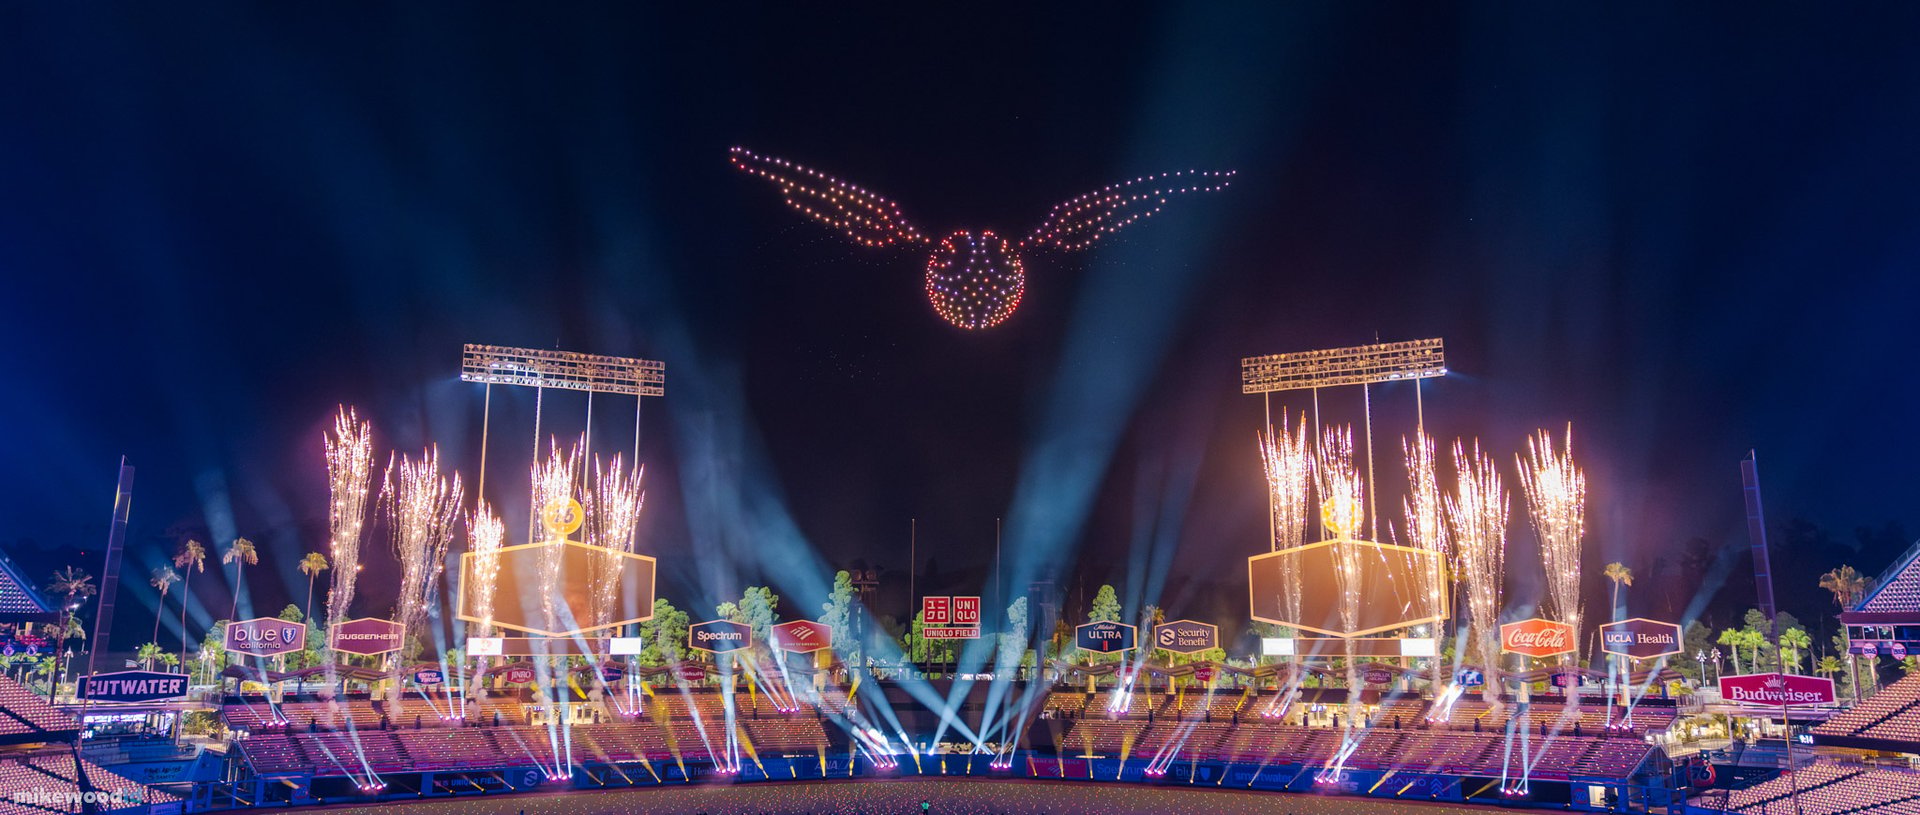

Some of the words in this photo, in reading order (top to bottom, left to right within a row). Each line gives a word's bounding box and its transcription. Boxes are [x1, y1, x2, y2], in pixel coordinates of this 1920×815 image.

[957, 600, 975, 610] UNI
[957, 611, 977, 621] QLO
[234, 625, 277, 641] blue
[697, 631, 742, 642] Spectrum
[926, 630, 954, 638] UNIQLO
[1088, 630, 1122, 639] ULTRA
[1177, 628, 1210, 639] Security
[1508, 628, 1567, 648] Coca-Cola
[1179, 638, 1206, 646] Benefit
[1607, 634, 1633, 643] UCLA
[1637, 633, 1674, 644] Health
[240, 641, 281, 649] california
[87, 679, 180, 696] CUTWATER
